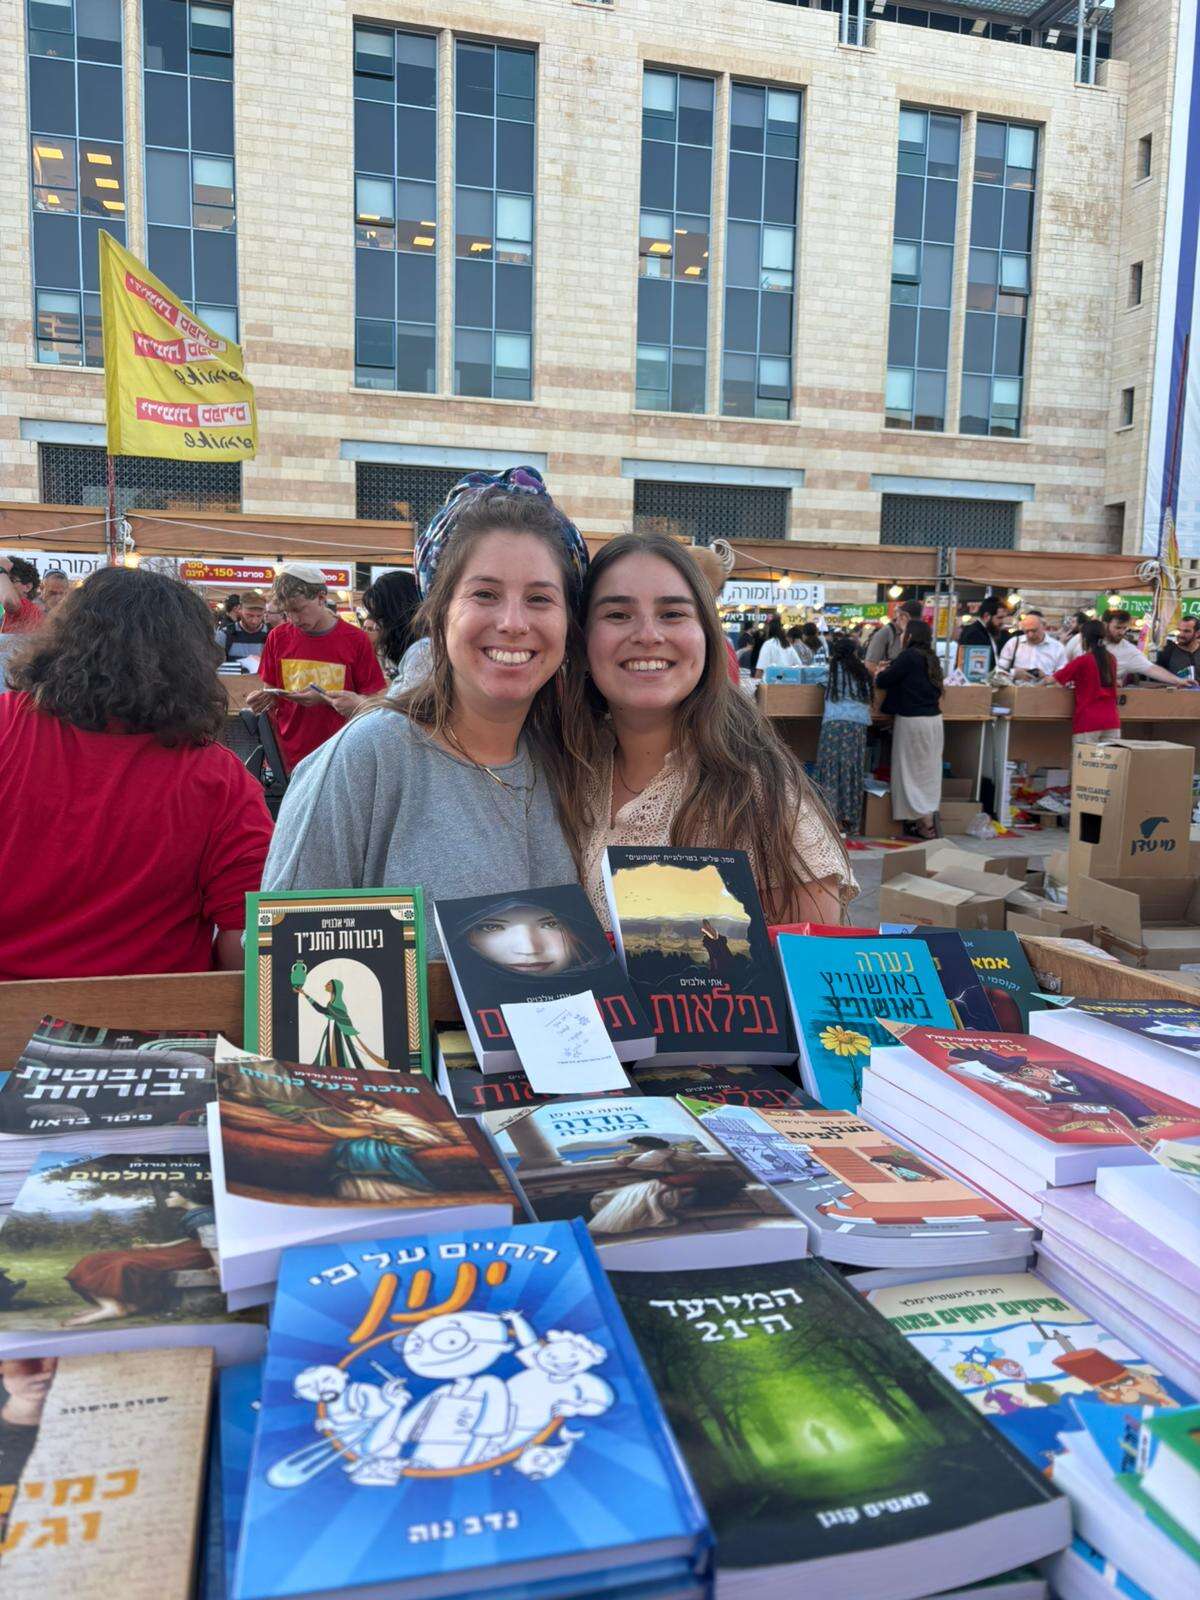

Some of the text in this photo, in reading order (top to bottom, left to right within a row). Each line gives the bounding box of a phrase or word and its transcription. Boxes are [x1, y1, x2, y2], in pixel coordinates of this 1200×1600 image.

[264, 569, 273, 579] 3
[338, 573, 346, 582] 2
[1130, 839, 1176, 856] מי עדן
[343, 918, 356, 928] אתי
[293, 930, 335, 954] התנ"ך
[855, 951, 914, 973] נערה
[969, 956, 1011, 970] אמא
[680, 977, 722, 987] אתי אלבוים
[819, 971, 926, 1000] באושוויץ
[648, 984, 779, 1034] נפלאות
[16, 1065, 206, 1082] הרובוטית
[24, 1082, 186, 1099] בורחת
[311, 1079, 354, 1092] בעל
[362, 1083, 421, 1095] מלכה
[29, 1113, 153, 1129] פיטר בראון
[551, 1113, 647, 1130] בודדה
[820, 1125, 875, 1133] מעבר
[785, 1131, 844, 1140] לפינה
[69, 1169, 185, 1182] כחולמים
[308, 1241, 558, 1286] החיים על פי
[648, 1286, 804, 1321] המיועד
[934, 1302, 998, 1324] ירוקים
[694, 1313, 793, 1342] ה-21
[407, 1509, 520, 1544] נדב נוה
